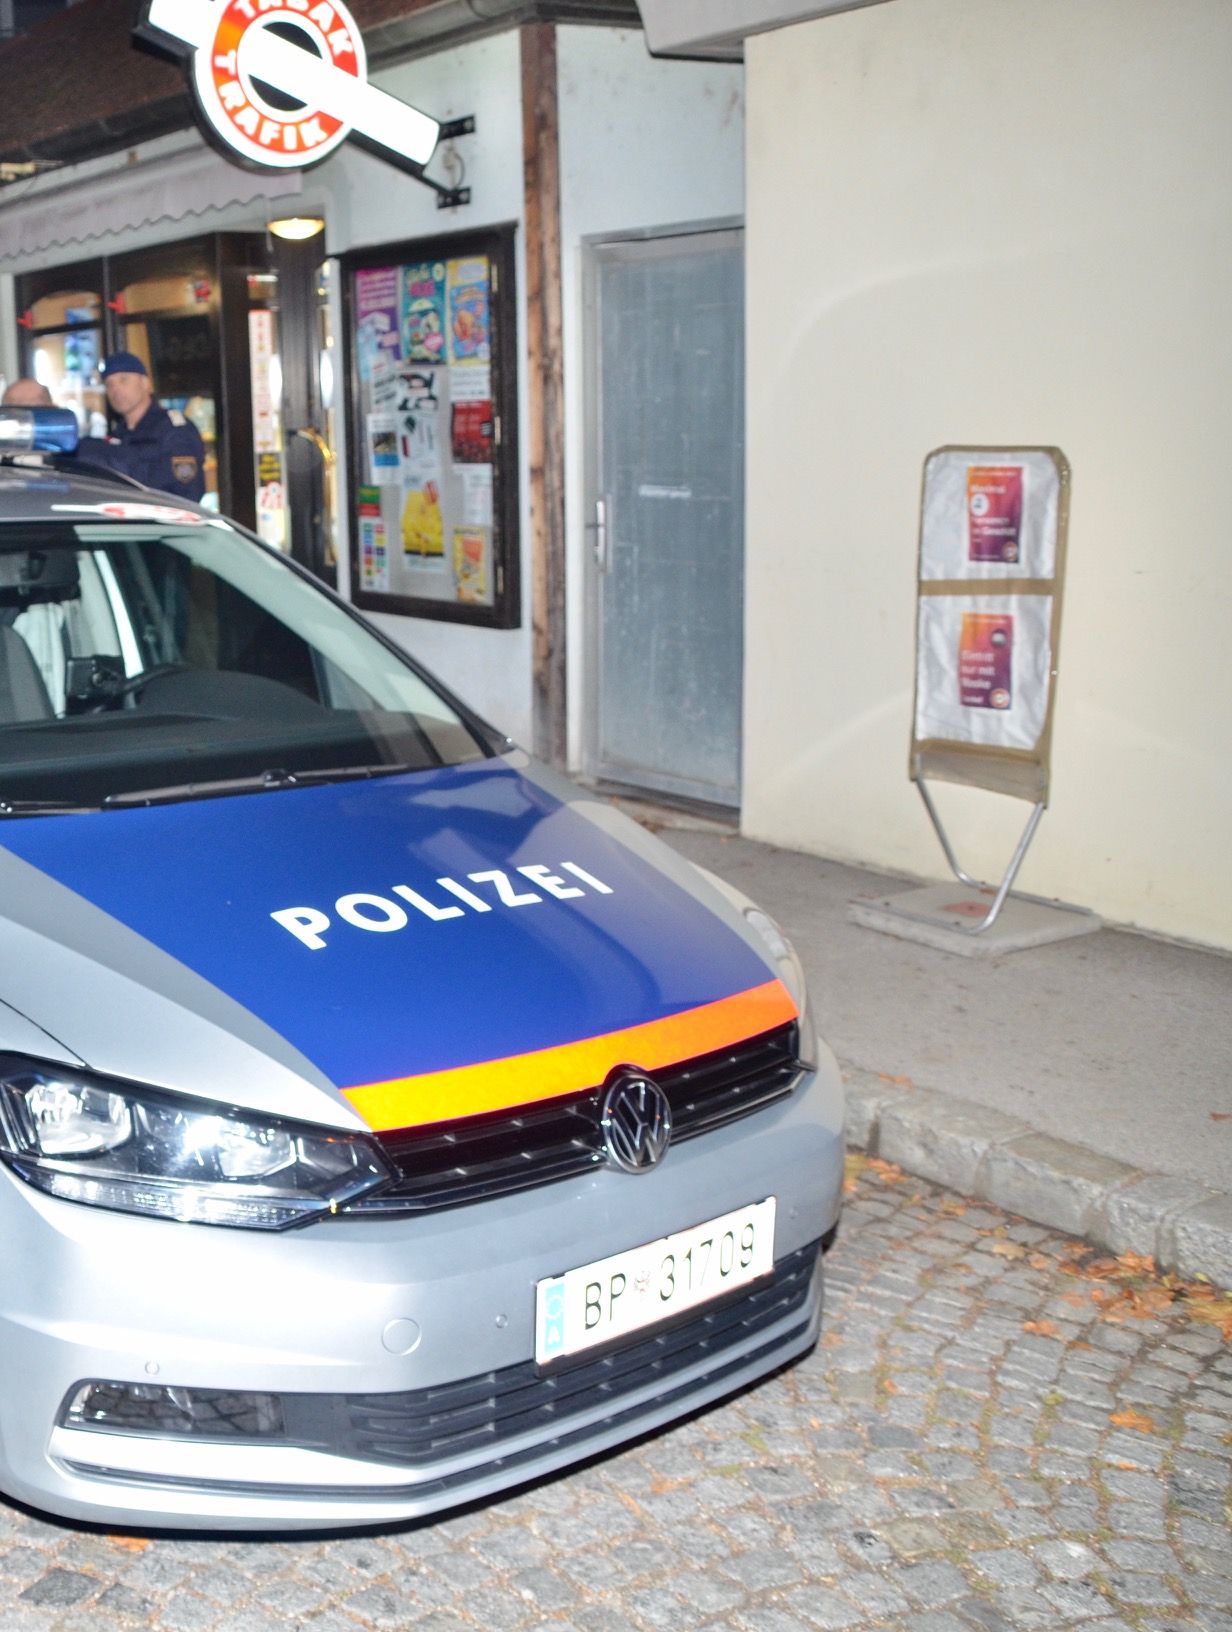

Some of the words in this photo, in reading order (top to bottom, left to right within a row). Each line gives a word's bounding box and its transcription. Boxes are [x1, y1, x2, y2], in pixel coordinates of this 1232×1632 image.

[214, 49, 328, 150] TRAFIK
[269, 861, 614, 951] POLIZEI
[584, 1272, 627, 1330] BP
[659, 1222, 755, 1301] 31709
